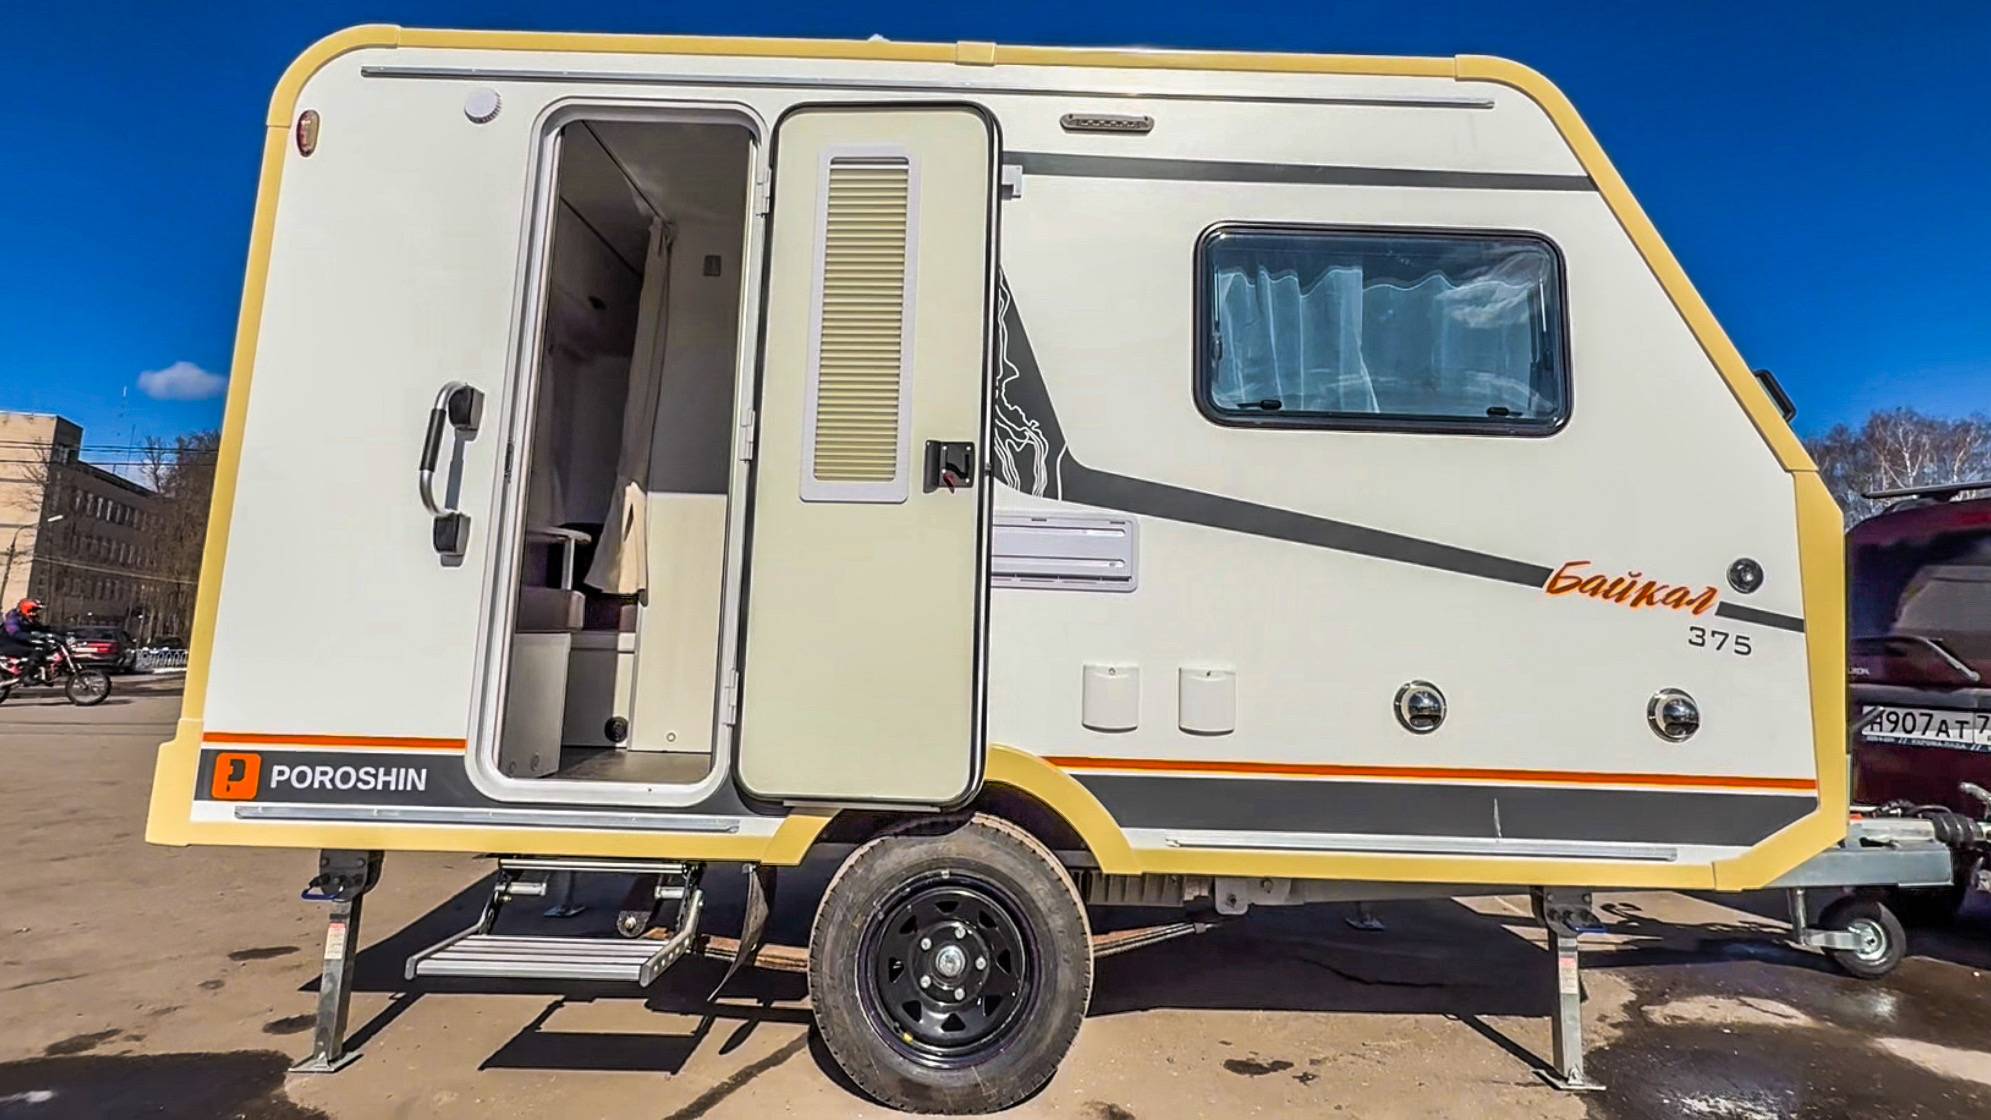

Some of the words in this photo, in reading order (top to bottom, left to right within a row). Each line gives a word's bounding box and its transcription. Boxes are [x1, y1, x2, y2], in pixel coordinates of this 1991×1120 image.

[1546, 560, 1719, 616] Байкал
[1688, 625, 1752, 656] 375
[270, 765, 428, 792] POROSHIN
